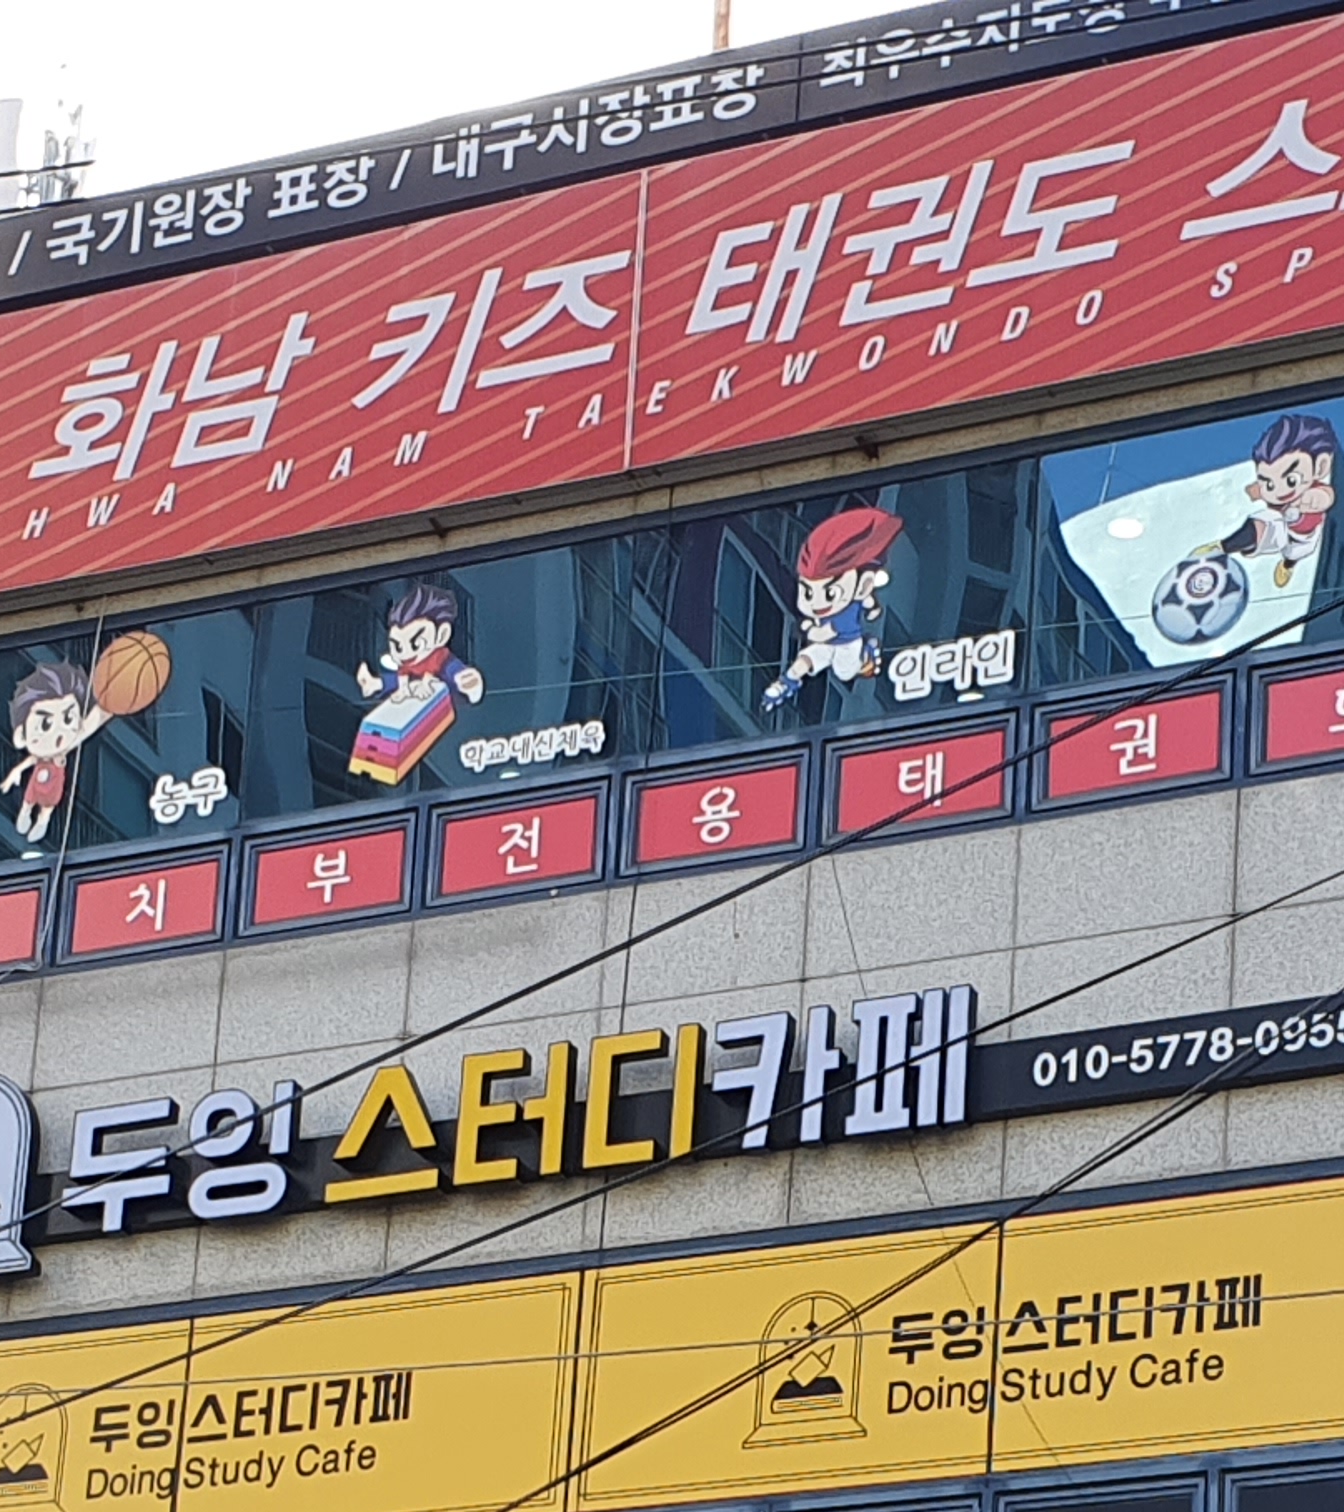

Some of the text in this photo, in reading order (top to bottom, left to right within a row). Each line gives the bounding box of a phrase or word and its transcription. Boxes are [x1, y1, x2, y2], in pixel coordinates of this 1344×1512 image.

[45, 178, 253, 266] 국기원장
[27, 311, 317, 482] 화남
[352, 248, 632, 413] 키즈
[685, 139, 1135, 345] 태권도
[22, 487, 175, 541] HWA
[266, 430, 428, 493] NAM
[522, 288, 1103, 442] TAEKWONDO
[890, 630, 1016, 700] 인라인
[149, 767, 229, 825] 농구
[62, 985, 972, 1234] 두잉 스터디카페
[887, 1274, 1263, 1365] 두잉 스터디카페
[89, 1371, 412, 1455] 두잉 스터디카페
[886, 1349, 1225, 1418] Doing Study Cafe
[85, 1438, 377, 1502] Doing Study Cafe
